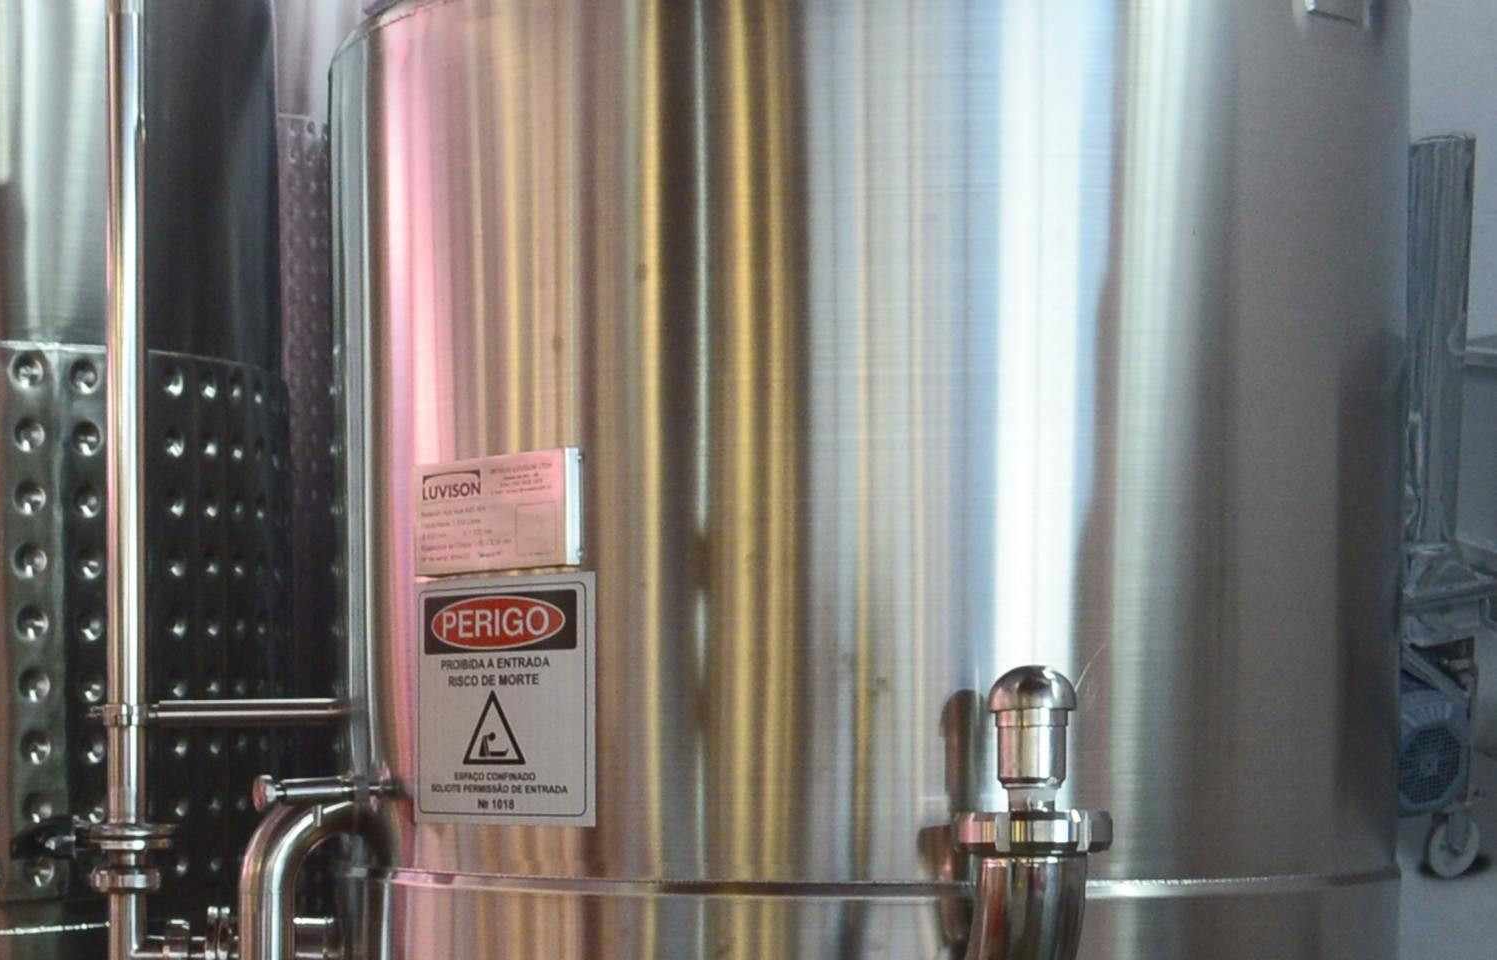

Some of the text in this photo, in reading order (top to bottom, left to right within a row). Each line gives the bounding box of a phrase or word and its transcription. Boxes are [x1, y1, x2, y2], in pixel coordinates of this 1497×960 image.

[422, 480, 481, 501] LUVISON
[441, 606, 550, 639] PERIGO
[440, 655, 550, 670] PROIBIDA A ENTRADA
[448, 673, 540, 687] RISCO DE MORTE
[454, 771, 536, 782] ESPAÇO CONFINADO
[431, 783, 568, 794] SOLICITE PERMISSÃO DE ENTRADA
[492, 799, 515, 810] 1018
